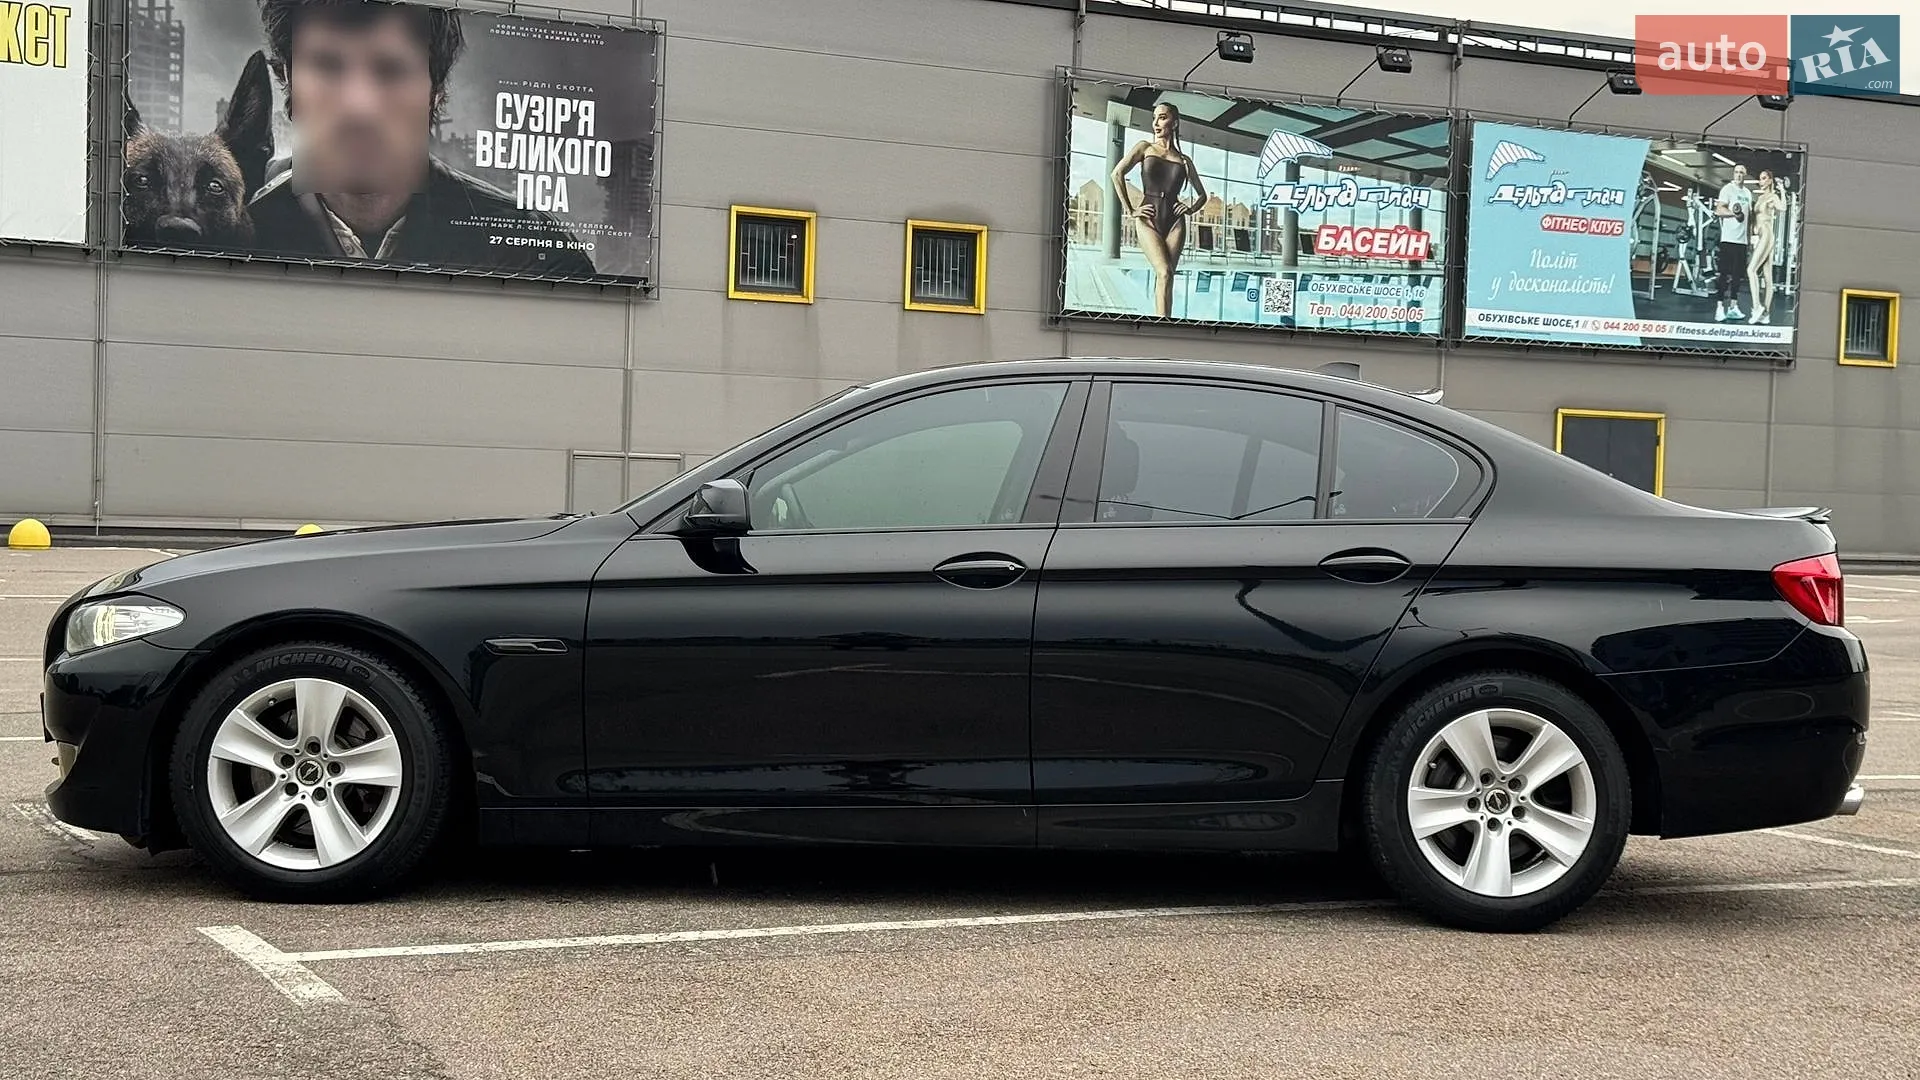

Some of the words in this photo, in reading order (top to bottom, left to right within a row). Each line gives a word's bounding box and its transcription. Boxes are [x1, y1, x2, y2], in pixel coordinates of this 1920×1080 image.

[522, 80, 551, 89] РІДЛІ
[556, 84, 594, 93] СКОТТА
[495, 92, 595, 137] СУЗІР'Я
[475, 129, 612, 178] ВЕЛИКОГО
[516, 172, 569, 213] ПСА
[1541, 216, 1588, 232] ФІТНЕС
[1589, 220, 1624, 234] КЛУБ
[489, 235, 503, 245] 27
[505, 237, 552, 248] СЕРПНЯ
[555, 240, 564, 249] В
[566, 241, 595, 251] КІНО
[1317, 227, 1428, 257] БАСЕЙН
[1530, 249, 1579, 270] Політ
[1311, 282, 1373, 295] ОБУХІВСЬКЕ
[1373, 286, 1402, 297] ШОСЕ
[1488, 275, 1502, 300] у
[1508, 270, 1615, 294] досконалість!
[1310, 303, 1335, 316] Тел.
[1339, 304, 1362, 318] 044
[1365, 306, 1388, 319] 200
[1390, 308, 1406, 320] 50
[1408, 308, 1424, 321] 05
[1478, 313, 1540, 326] ОБУХІВСЬКЕ
[1603, 321, 1620, 330] 044
[1622, 322, 1639, 331] 200
[1641, 324, 1654, 333] 50
[1655, 324, 1667, 333] 05
[1675, 326, 1782, 339] fitness.deltaplan.kiev.ua
[255, 653, 349, 673] MICHELIN
[1401, 686, 1474, 747] MICHELIN
